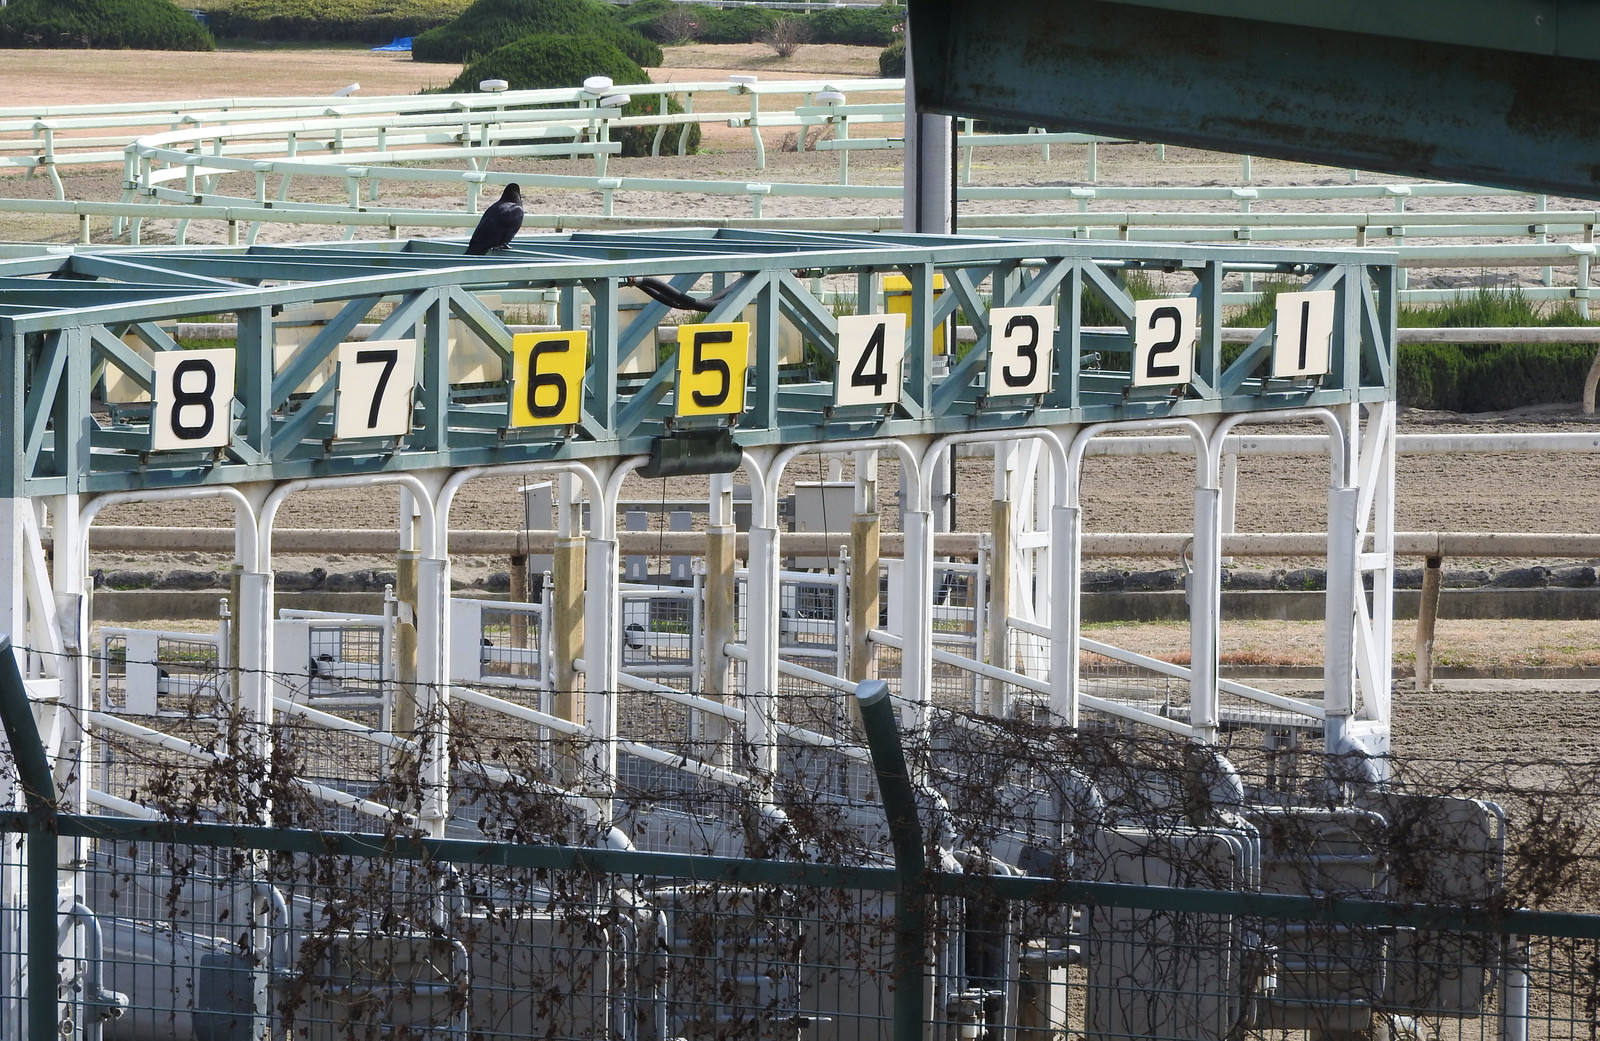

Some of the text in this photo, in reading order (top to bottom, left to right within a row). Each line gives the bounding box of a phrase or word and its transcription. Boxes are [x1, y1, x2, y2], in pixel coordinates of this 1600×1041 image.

[691, 330, 733, 408] 5
[851, 323, 888, 396] 4
[1002, 314, 1039, 388] 3
[1146, 306, 1182, 378] 2
[1298, 301, 1311, 371] 1
[170, 358, 216, 440] 8
[356, 350, 398, 429] 7
[526, 339, 570, 419] 6
